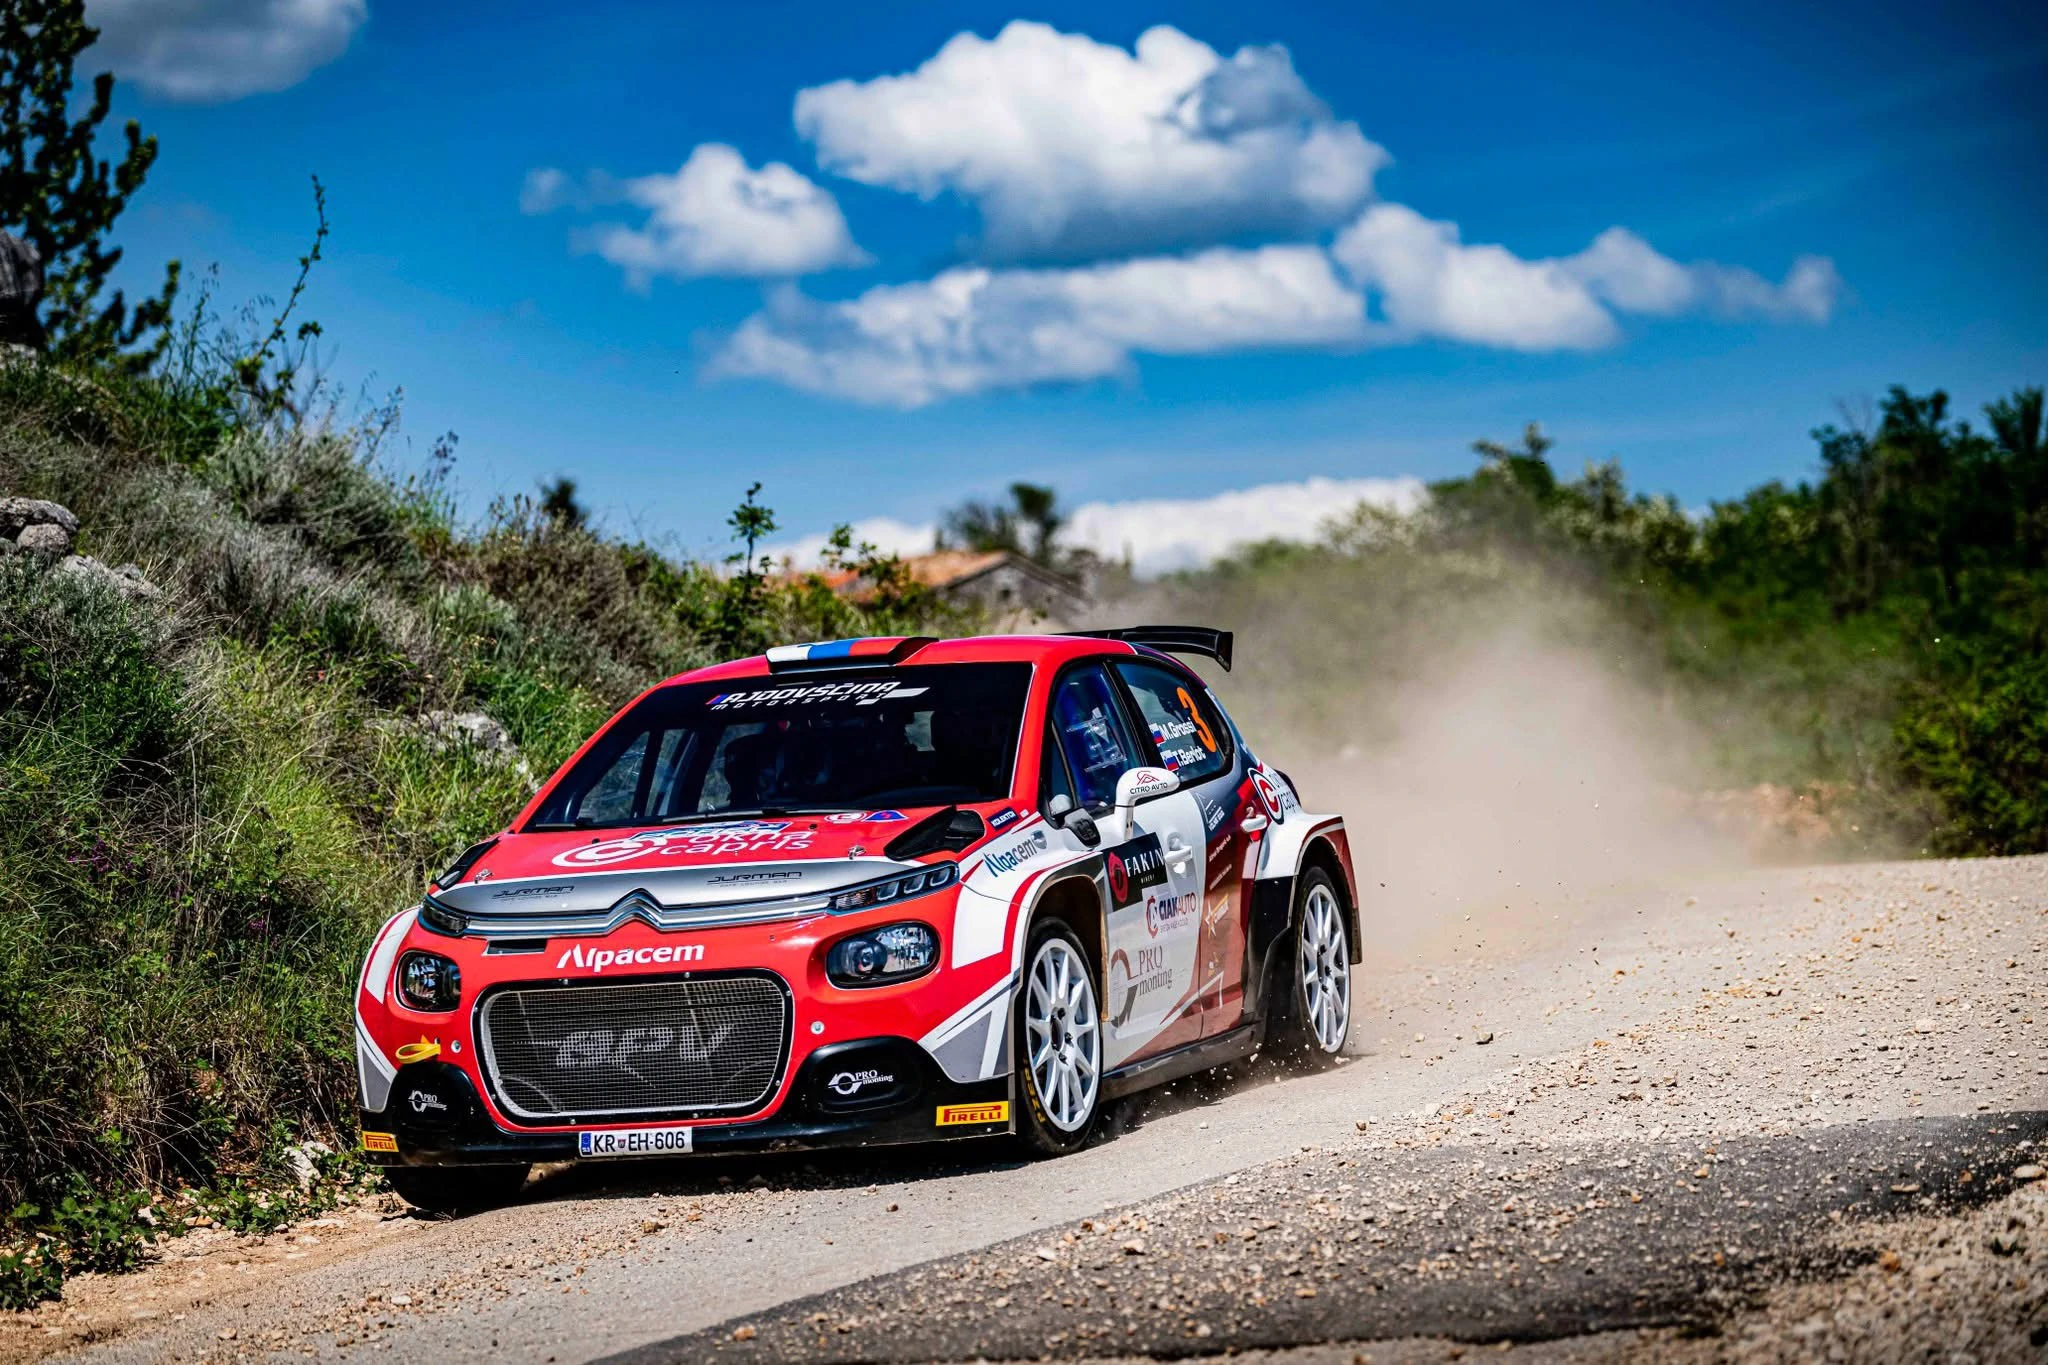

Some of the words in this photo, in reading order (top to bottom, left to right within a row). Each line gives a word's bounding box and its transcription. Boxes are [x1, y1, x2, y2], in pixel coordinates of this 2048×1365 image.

[711, 692, 887, 710] MOTORSPORT
[1176, 686, 1217, 752] 3
[1129, 784, 1150, 795] CITRO
[660, 838, 814, 855] capris
[983, 837, 1039, 878] Alpacem
[1124, 847, 1167, 878] FAKIN
[707, 871, 803, 883] JURMAN
[493, 885, 576, 897] JURMAN
[556, 943, 705, 972] Alpacem
[1138, 945, 1163, 976] PRO
[1138, 968, 1173, 997] monting
[855, 1069, 878, 1081] PRO
[862, 1073, 894, 1085] monting
[423, 1093, 438, 1103] PRO
[943, 1105, 1002, 1123] PIRELLI
[365, 1134, 395, 1150] PIRELLI
[594, 1134, 616, 1153] KR
[628, 1131, 685, 1152] EH-606
